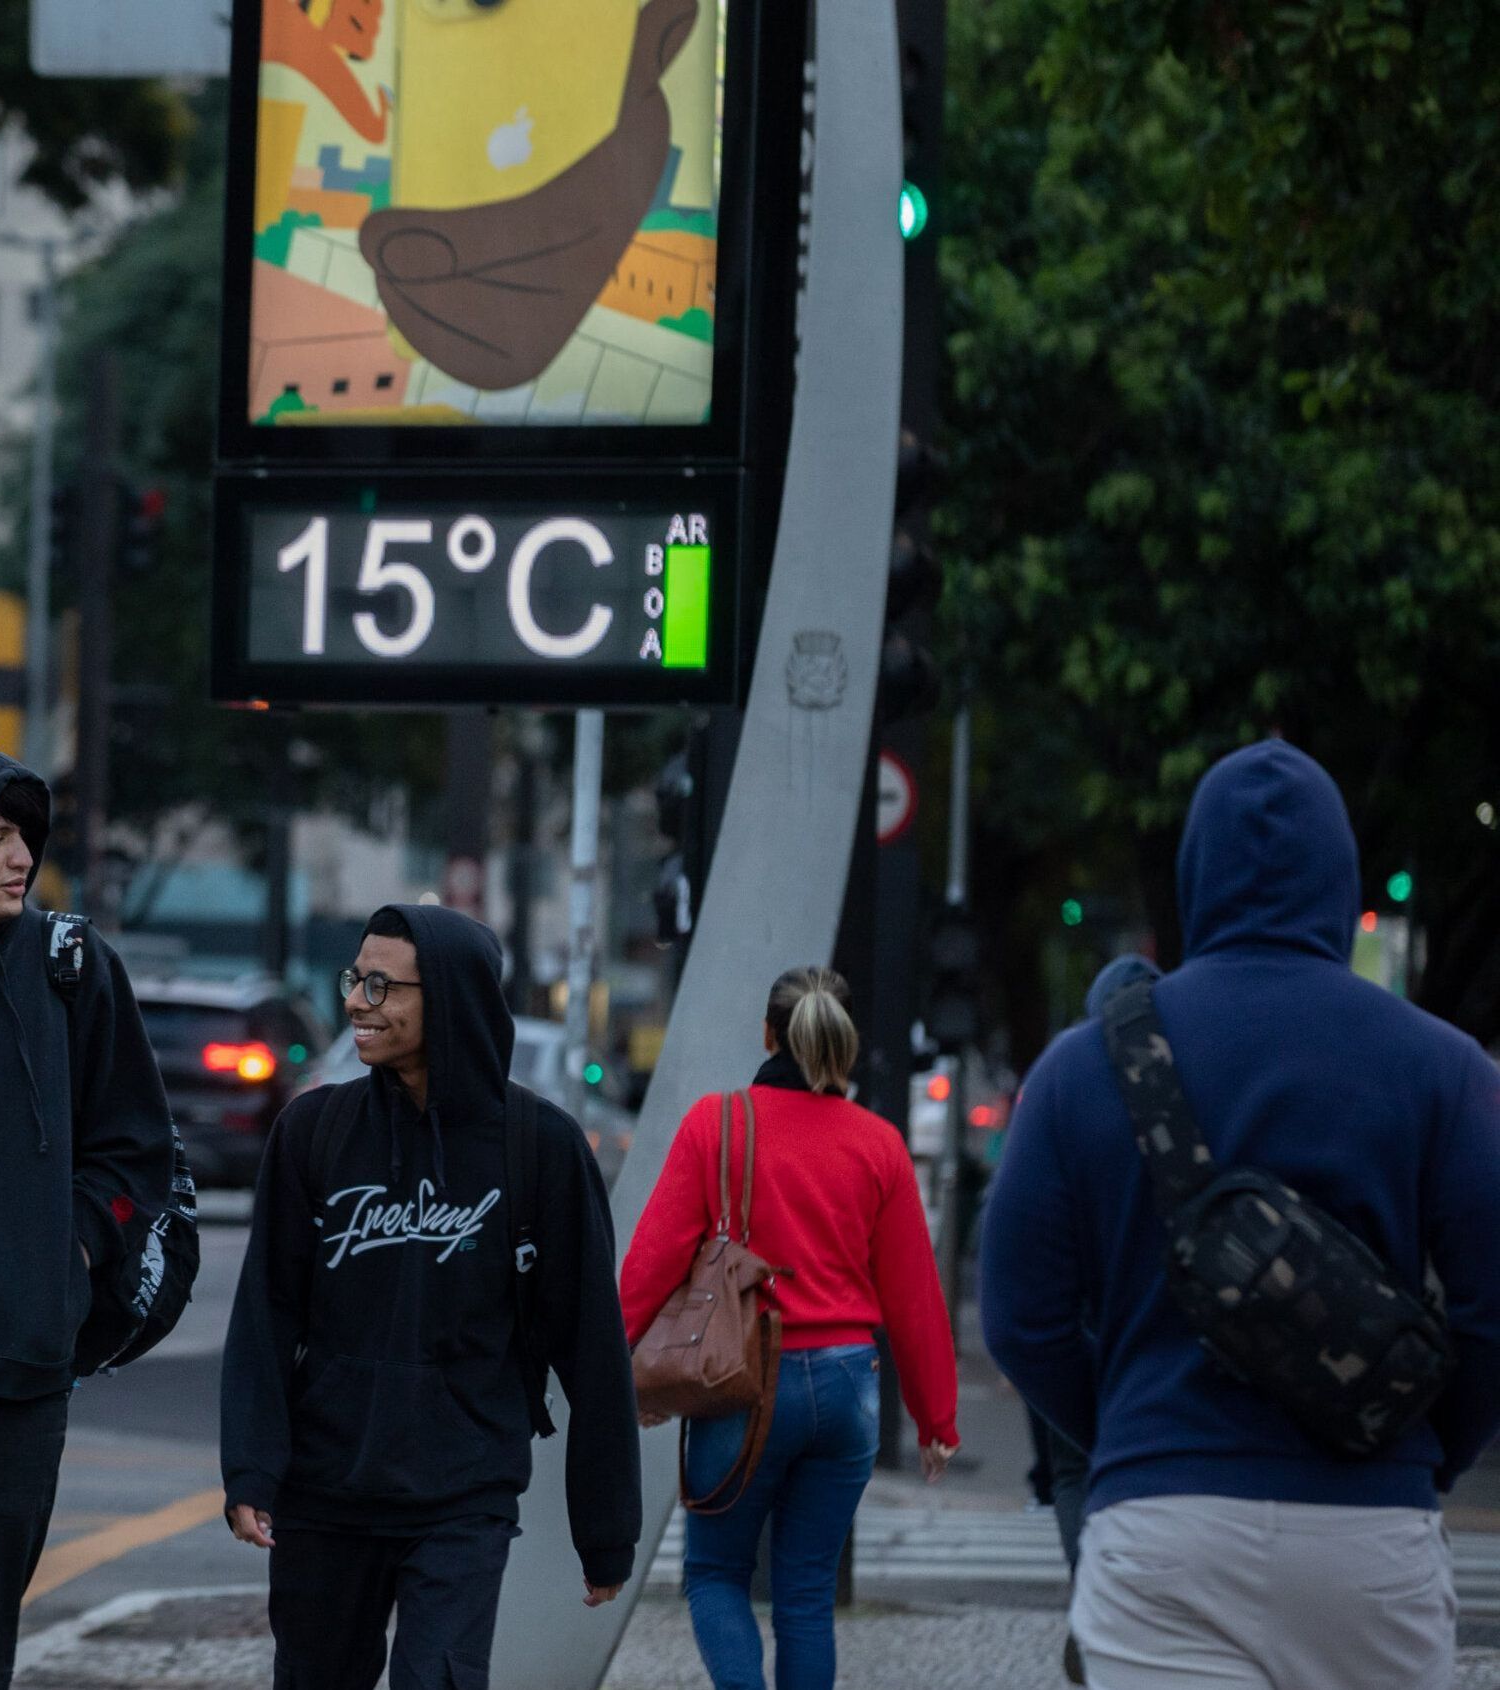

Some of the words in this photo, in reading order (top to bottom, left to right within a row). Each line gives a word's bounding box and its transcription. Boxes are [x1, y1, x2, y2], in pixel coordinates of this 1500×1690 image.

[278, 514, 614, 658] 15°C
[665, 513, 708, 545] AR
[639, 543, 664, 659] BOA
